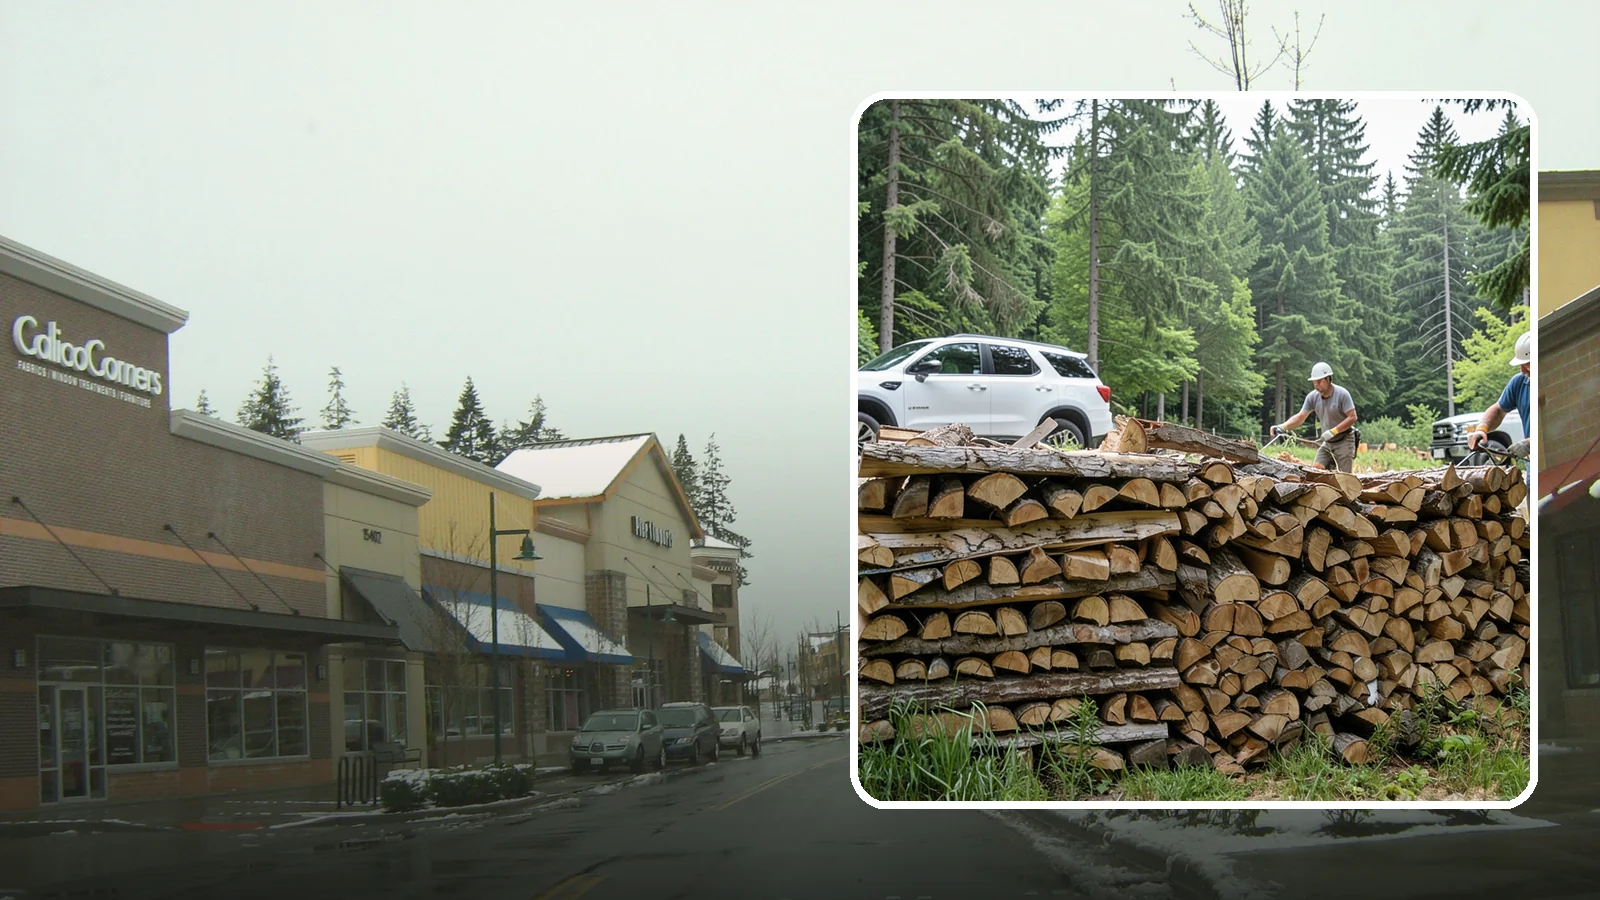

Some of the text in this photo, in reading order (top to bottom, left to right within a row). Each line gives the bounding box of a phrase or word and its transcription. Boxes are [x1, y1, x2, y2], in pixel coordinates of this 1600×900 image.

[17, 360, 47, 377] FABRICS
[51, 370, 78, 386] WINDOW
[79, 379, 116, 398] TREATMENTS
